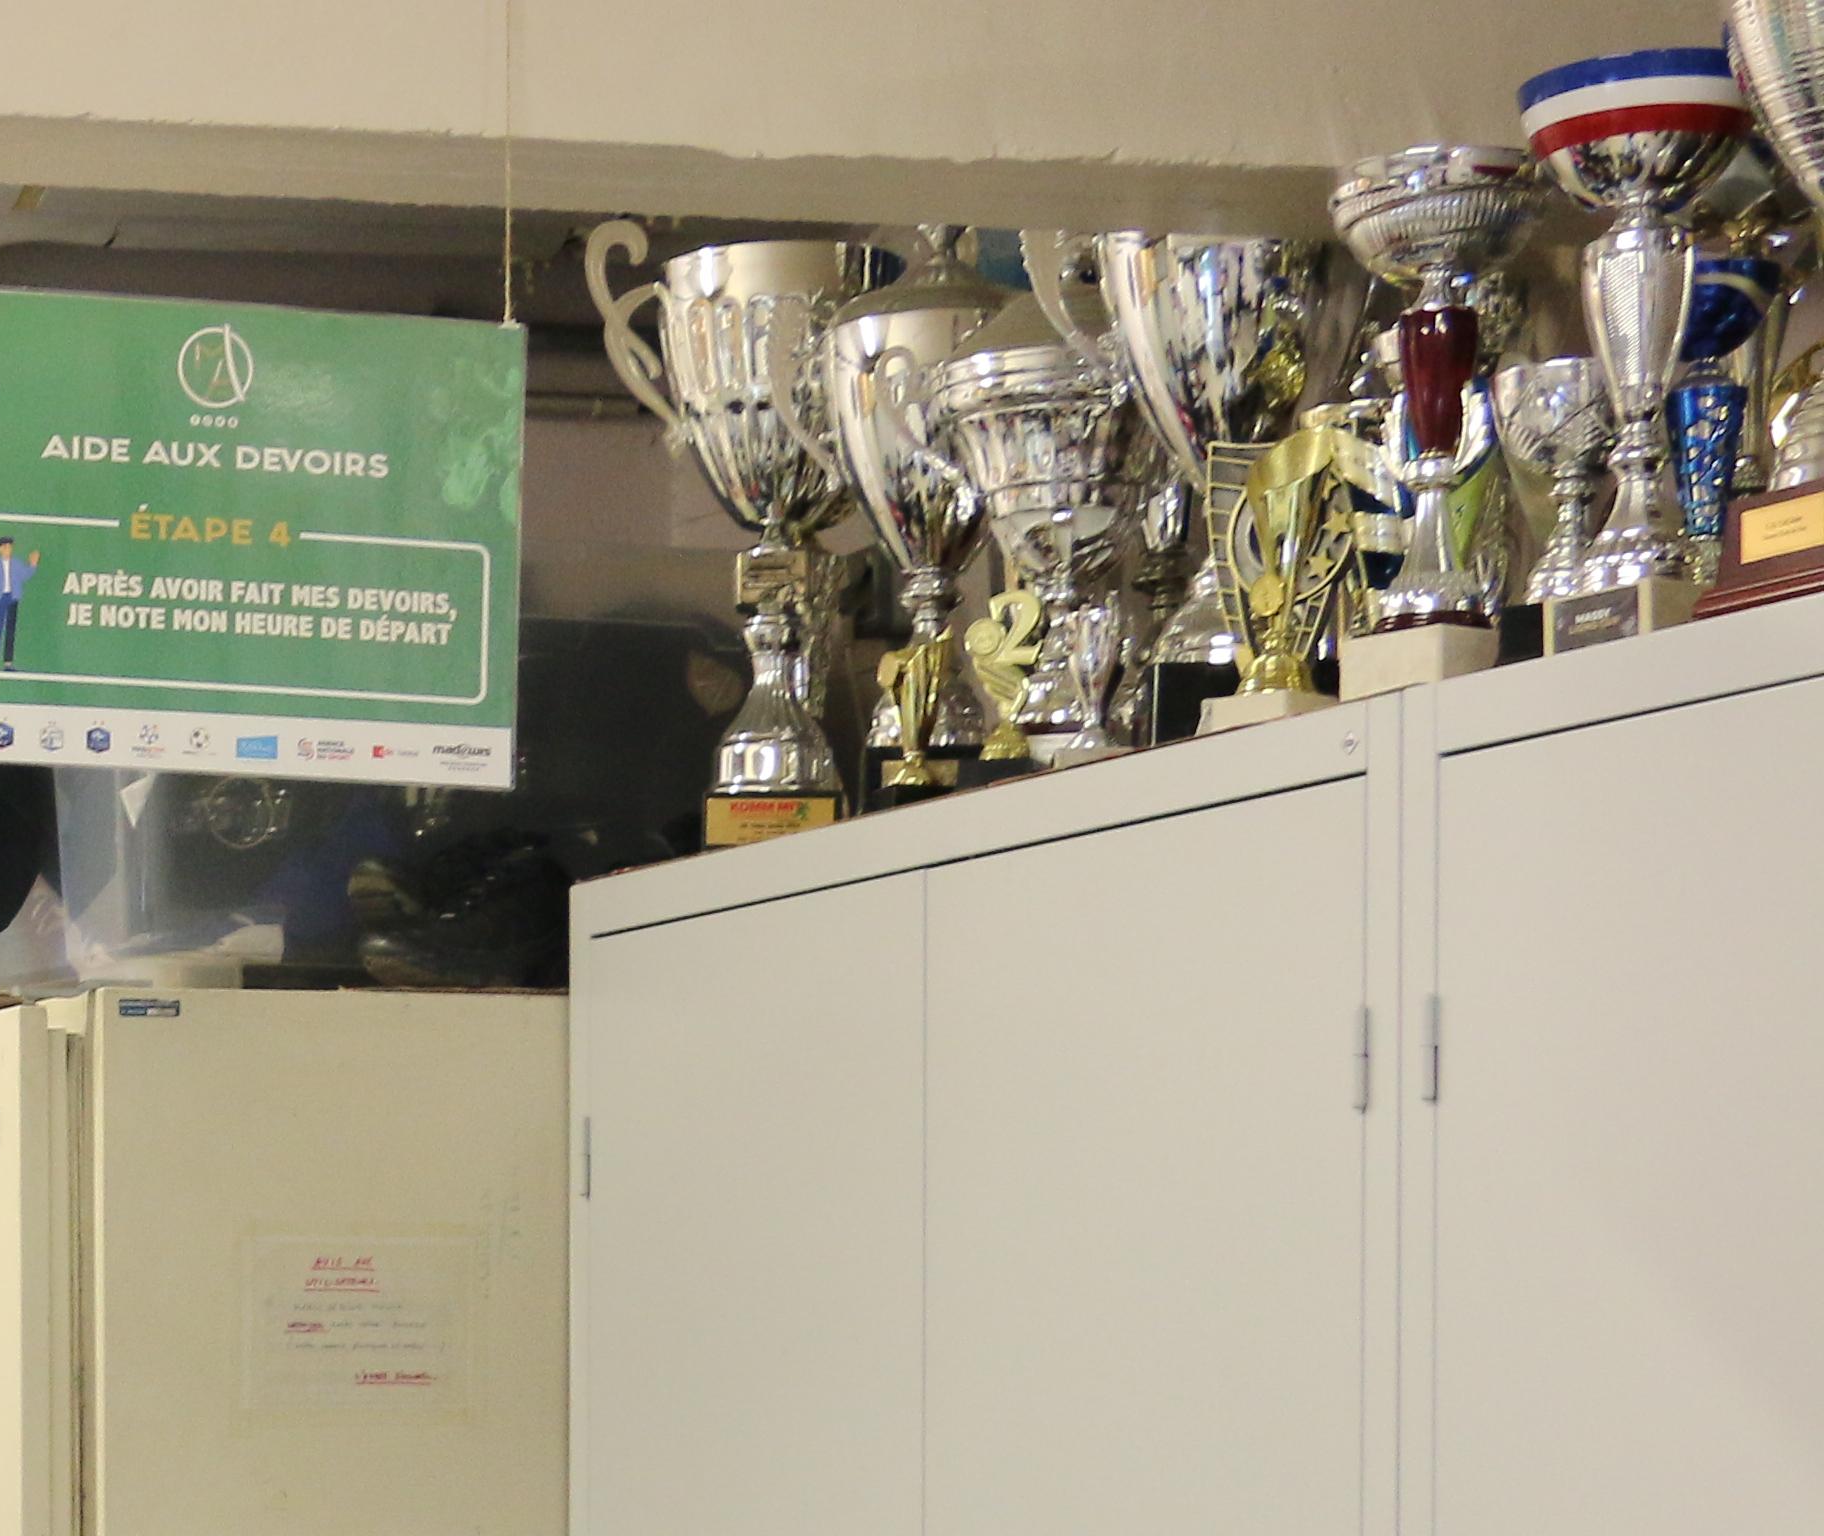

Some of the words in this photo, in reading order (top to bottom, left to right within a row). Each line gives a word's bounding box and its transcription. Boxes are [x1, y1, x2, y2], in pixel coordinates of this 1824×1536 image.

[41, 435, 130, 462] AIDE
[143, 441, 221, 467] AUX
[236, 446, 388, 478] DEVOIRS
[131, 504, 253, 545] ÉTAPE
[269, 522, 291, 546] 4
[63, 570, 143, 597] APRÈS
[150, 577, 223, 601] AVOIR
[231, 581, 285, 605] FAIT
[292, 585, 340, 608] MES
[346, 587, 457, 622] DEVOIRS,
[67, 603, 92, 626] JE
[100, 605, 165, 629] NOTE
[173, 609, 227, 632] MON
[235, 612, 313, 637] HEURE
[321, 617, 352, 639] DE
[359, 613, 452, 645] DÉPART
